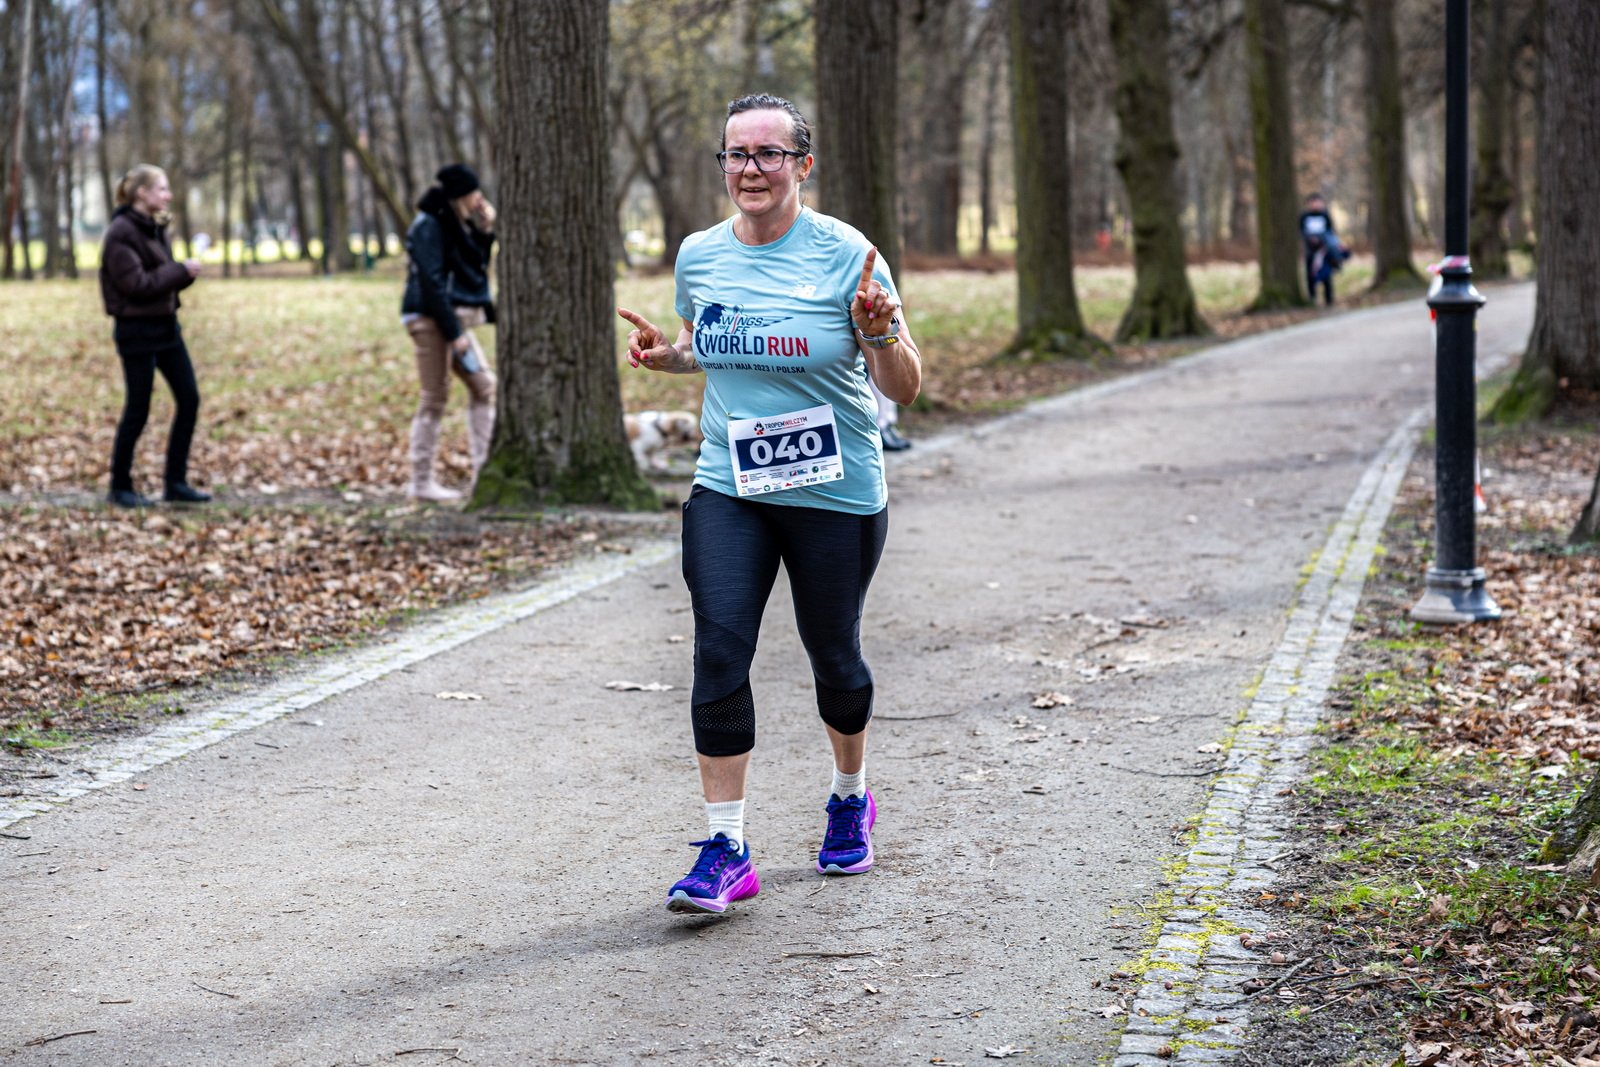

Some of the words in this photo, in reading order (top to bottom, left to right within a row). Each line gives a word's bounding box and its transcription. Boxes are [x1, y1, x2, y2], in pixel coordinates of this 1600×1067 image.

[721, 314, 764, 326] WINGS
[724, 326, 750, 335] LIFE
[704, 334, 764, 355] WORLD
[767, 336, 809, 357] RUN
[703, 361, 724, 370] EDYCJA
[734, 362, 752, 371] MAJA
[753, 364, 770, 372] 2023
[776, 365, 806, 374] POLSKA
[749, 431, 823, 466] 040
